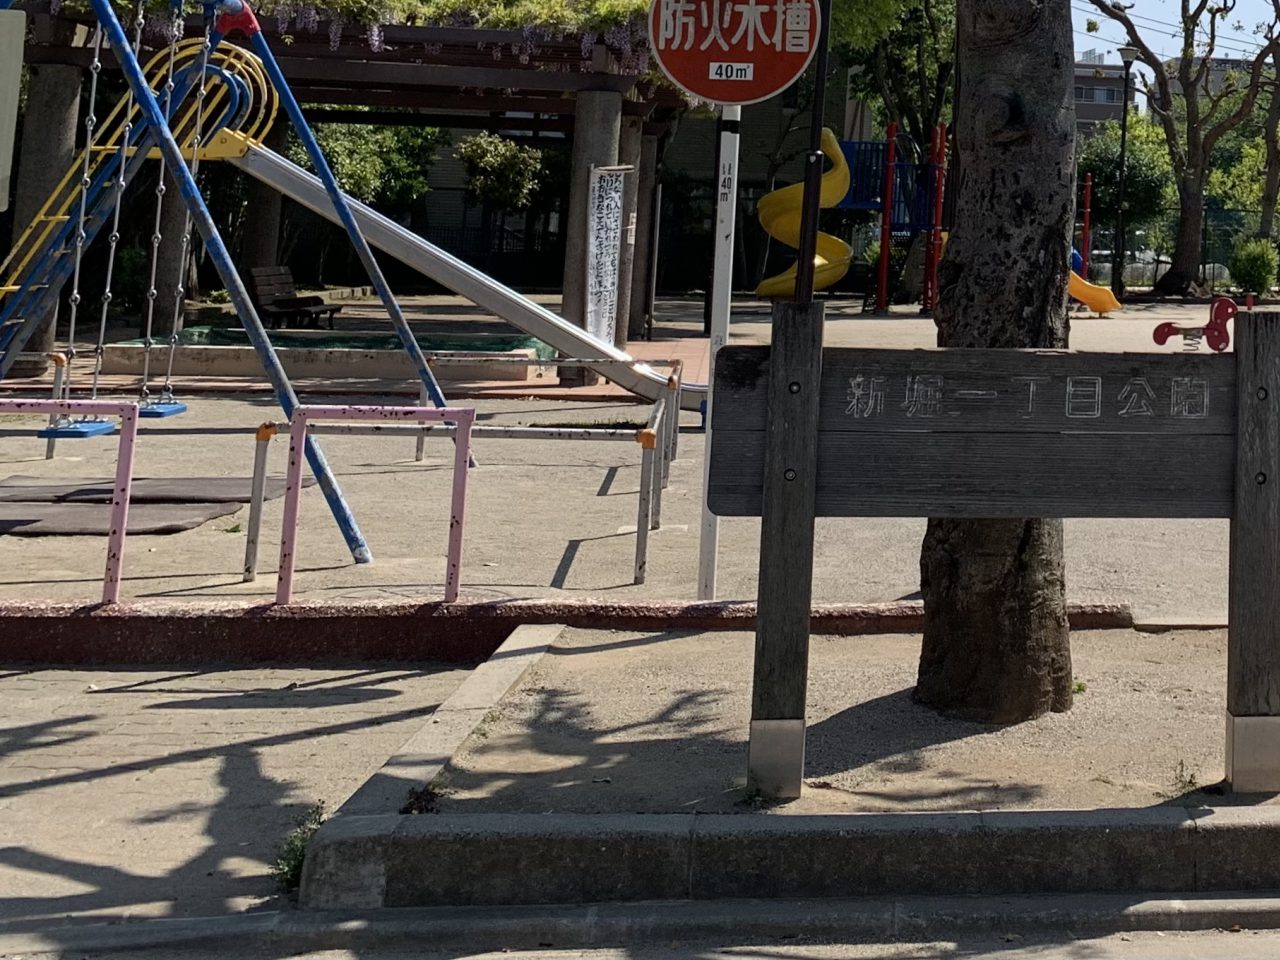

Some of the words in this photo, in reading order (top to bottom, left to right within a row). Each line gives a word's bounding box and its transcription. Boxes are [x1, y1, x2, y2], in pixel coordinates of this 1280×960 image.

[721, 176, 732, 190] 40
[845, 373, 1210, 419] 新堀一丁目公園
